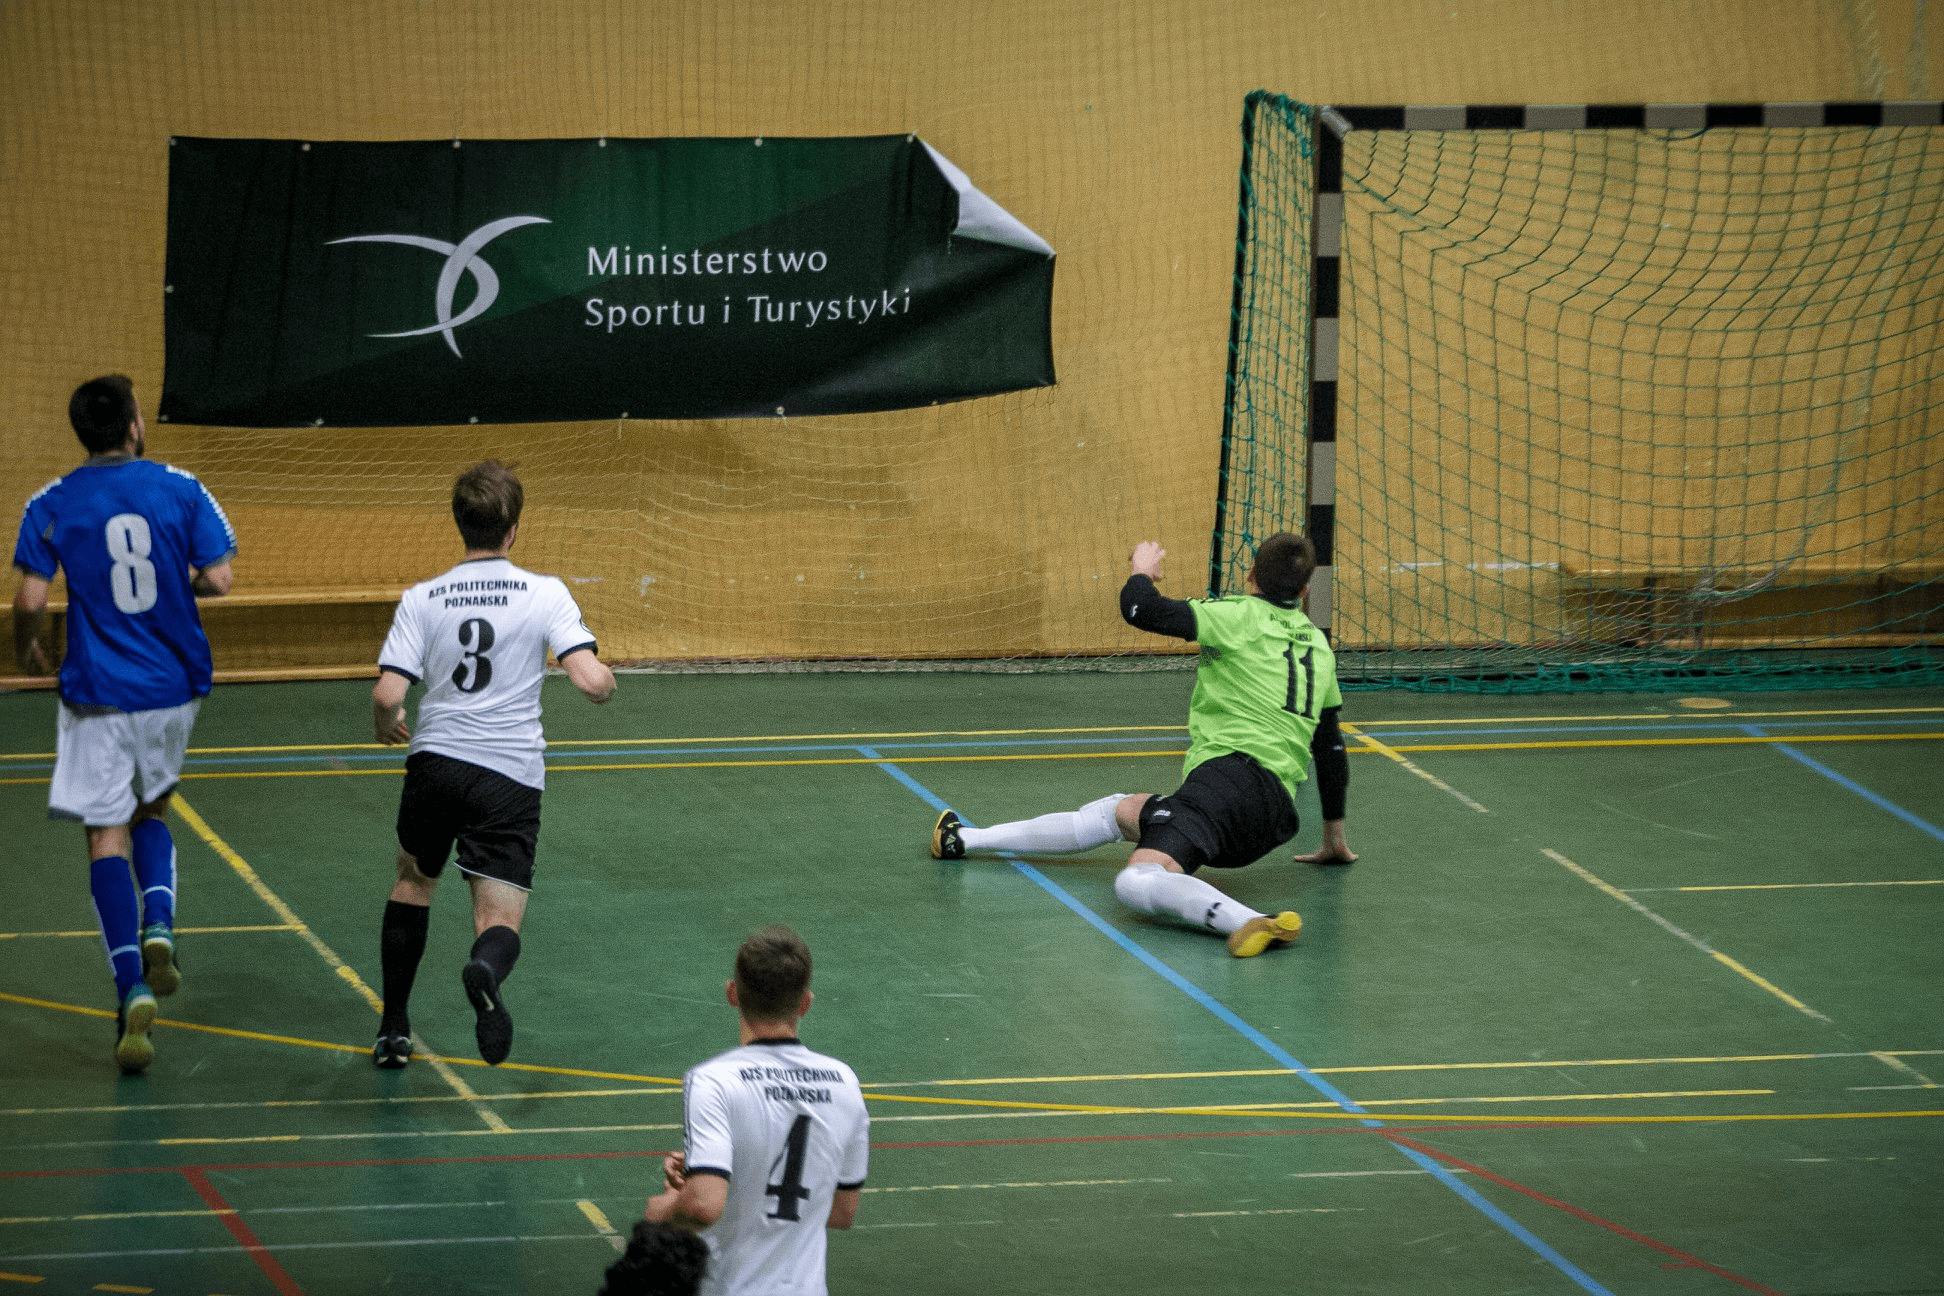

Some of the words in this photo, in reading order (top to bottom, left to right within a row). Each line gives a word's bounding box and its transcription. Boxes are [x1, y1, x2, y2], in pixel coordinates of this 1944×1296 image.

[587, 245, 828, 276] Ministerstwo
[585, 299, 705, 333] Sportu
[722, 296, 730, 324] i
[747, 287, 911, 329] Turystyki
[105, 513, 158, 614] 8
[450, 580, 528, 593] POLITECHNIKA
[452, 617, 496, 694] 3
[1281, 641, 1316, 720] 11
[765, 1113, 812, 1222] 4
